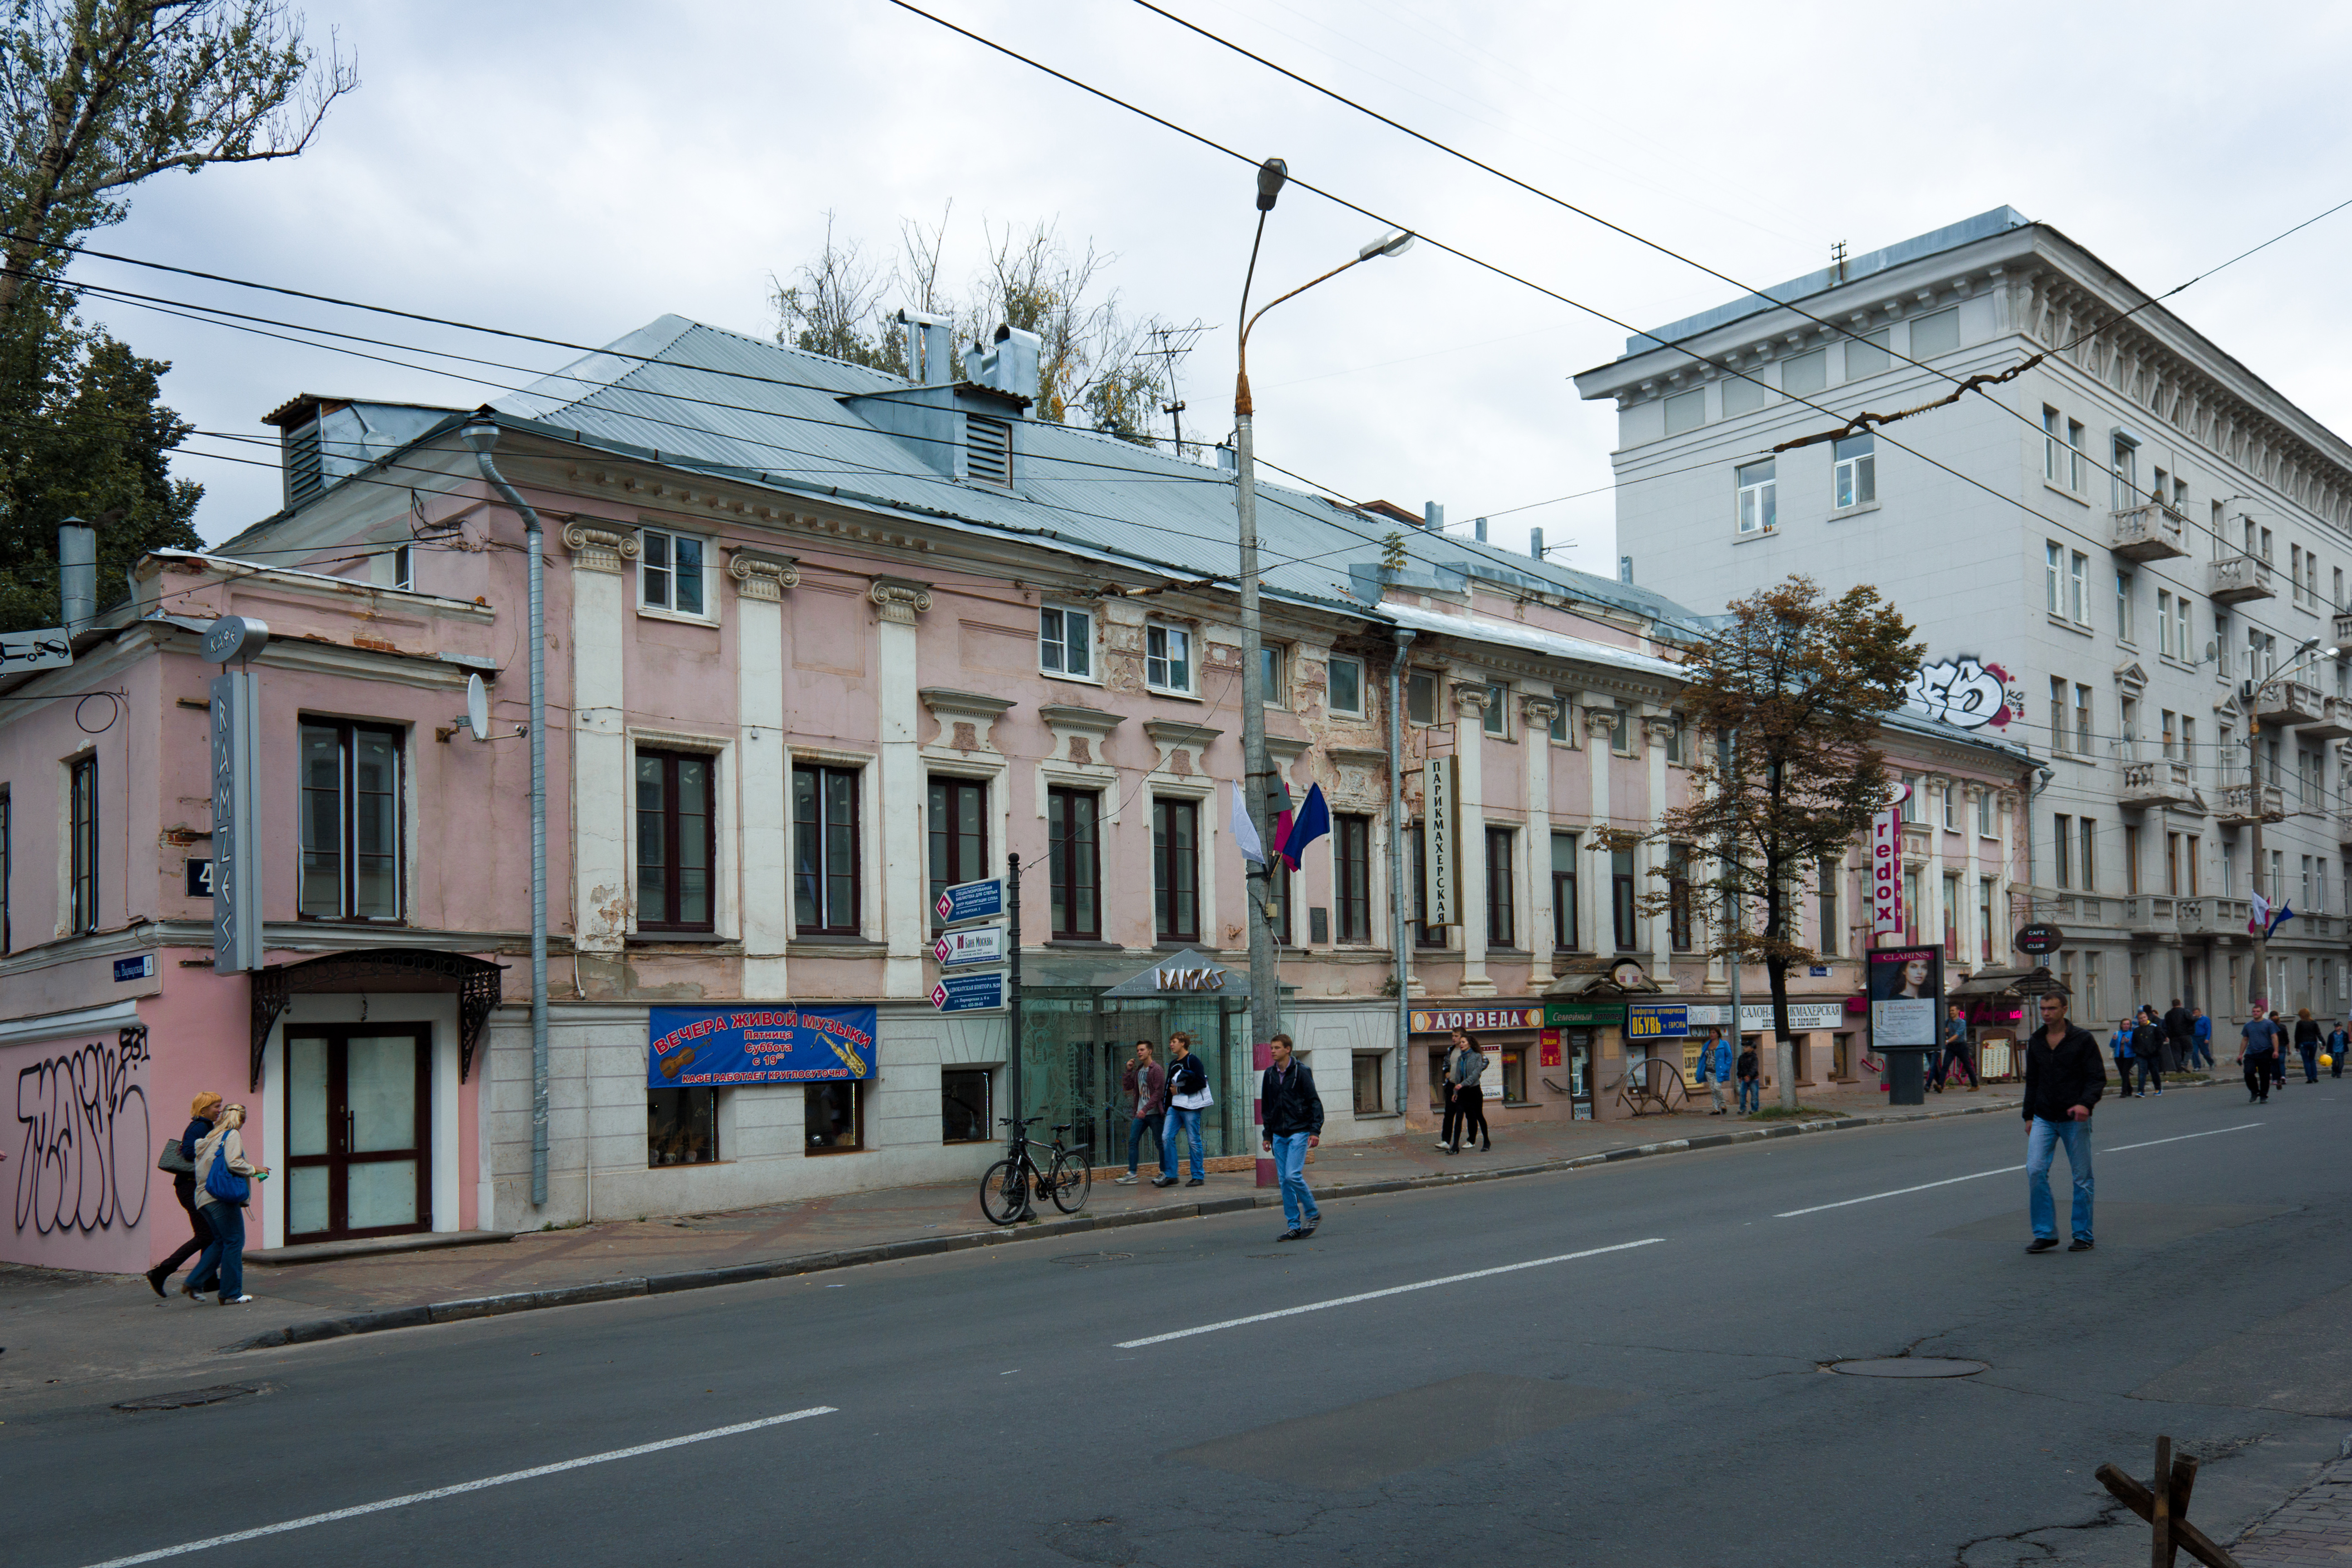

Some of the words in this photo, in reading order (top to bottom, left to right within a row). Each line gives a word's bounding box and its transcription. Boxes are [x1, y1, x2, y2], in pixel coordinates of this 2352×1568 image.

[217, 695, 232, 955] RAMZES
[1433, 761, 1445, 924] ПАРИКМАХЕРСКАЯ
[1876, 823, 1893, 921] redox
[1883, 952, 1930, 960] CLARINS
[1155, 968, 1227, 990] RAMZES
[949, 985, 973, 993] АДВОКАТСКАЯ
[1436, 1011, 1520, 1029] АЮРВЕДА
[1553, 1012, 1592, 1022] Семейный
[1594, 1013, 1623, 1023] ортопед
[1632, 1016, 1661, 1034] ОБУВЬ
[653, 1016, 729, 1055] ВЕЧЕРА
[731, 1010, 798, 1029] ЖИВОЙ
[802, 1014, 872, 1049] МУЗЫКИ
[744, 1030, 794, 1040] Пятница
[745, 1042, 793, 1055] Суббота
[682, 1073, 711, 1083] КАФЕ
[713, 1071, 766, 1083] РАБОТАЕТ
[768, 1068, 848, 1080] КРУГЛОСУТОЧНО
